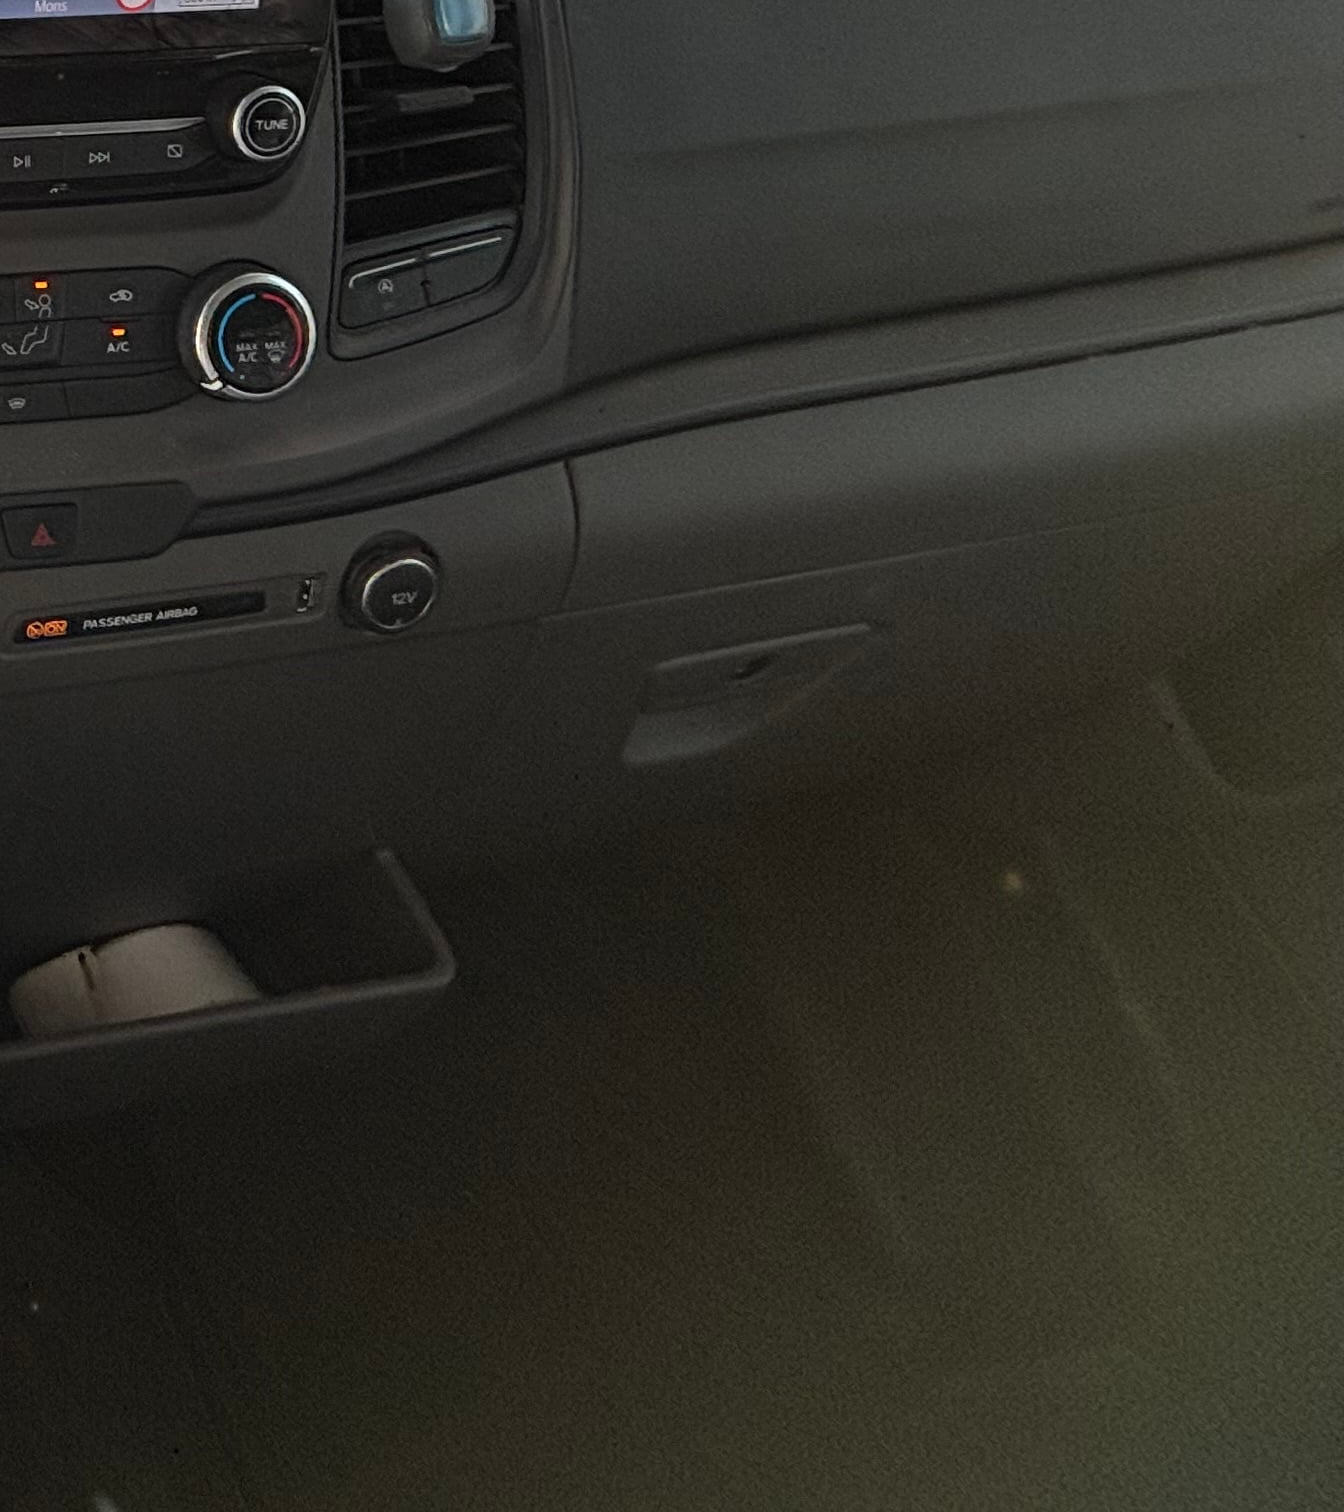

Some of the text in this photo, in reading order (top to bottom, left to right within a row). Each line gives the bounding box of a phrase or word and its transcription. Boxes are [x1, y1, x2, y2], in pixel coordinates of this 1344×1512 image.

[34, 0, 68, 13] Mons
[255, 118, 289, 131] TUNE
[106, 341, 131, 354] A/C
[236, 343, 258, 353] MAX
[264, 341, 287, 350] MAX
[238, 351, 258, 363] A/C
[392, 591, 418, 605] 12V
[82, 605, 199, 631] PASSENGER AIRBAG
